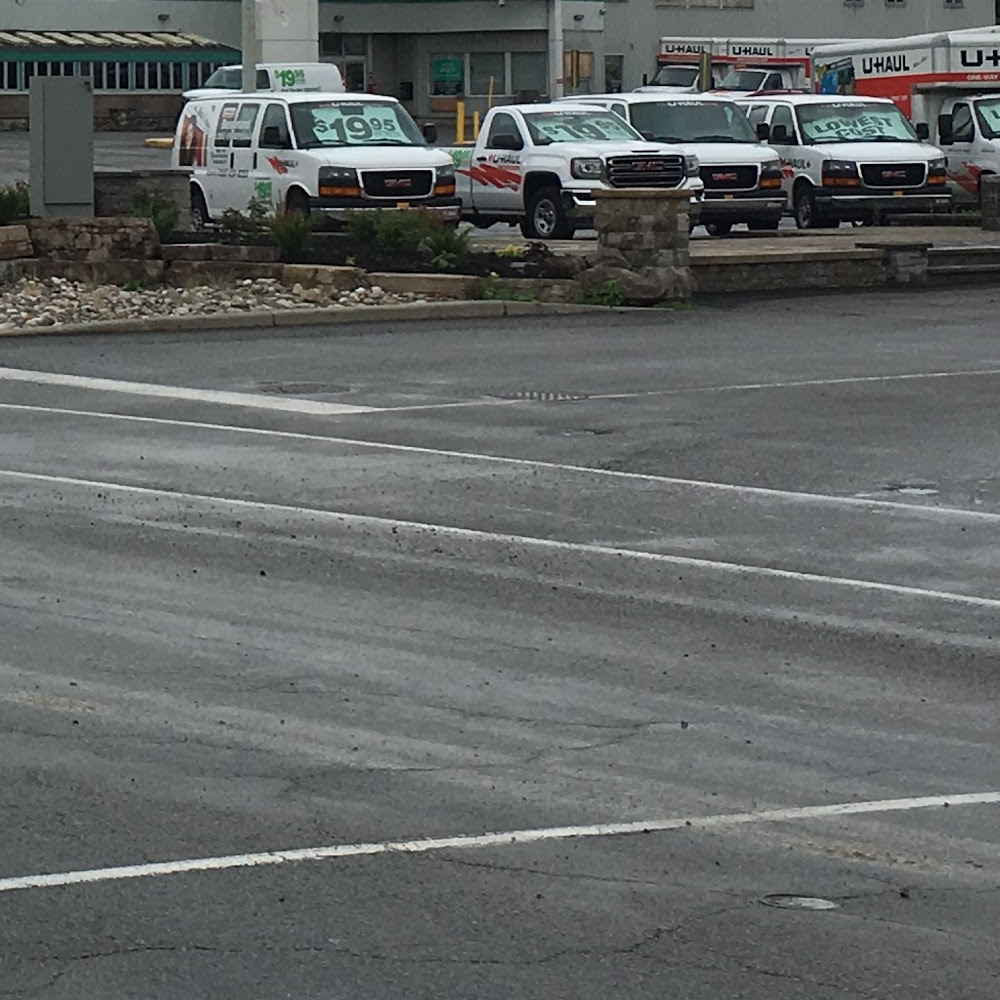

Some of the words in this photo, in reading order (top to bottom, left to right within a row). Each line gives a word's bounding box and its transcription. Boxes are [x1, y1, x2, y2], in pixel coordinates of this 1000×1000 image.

[665, 44, 708, 54] U-HAUL
[732, 46, 773, 56] U-HAUL
[862, 54, 910, 74] U-HAUL
[813, 115, 895, 133] LOWEST
